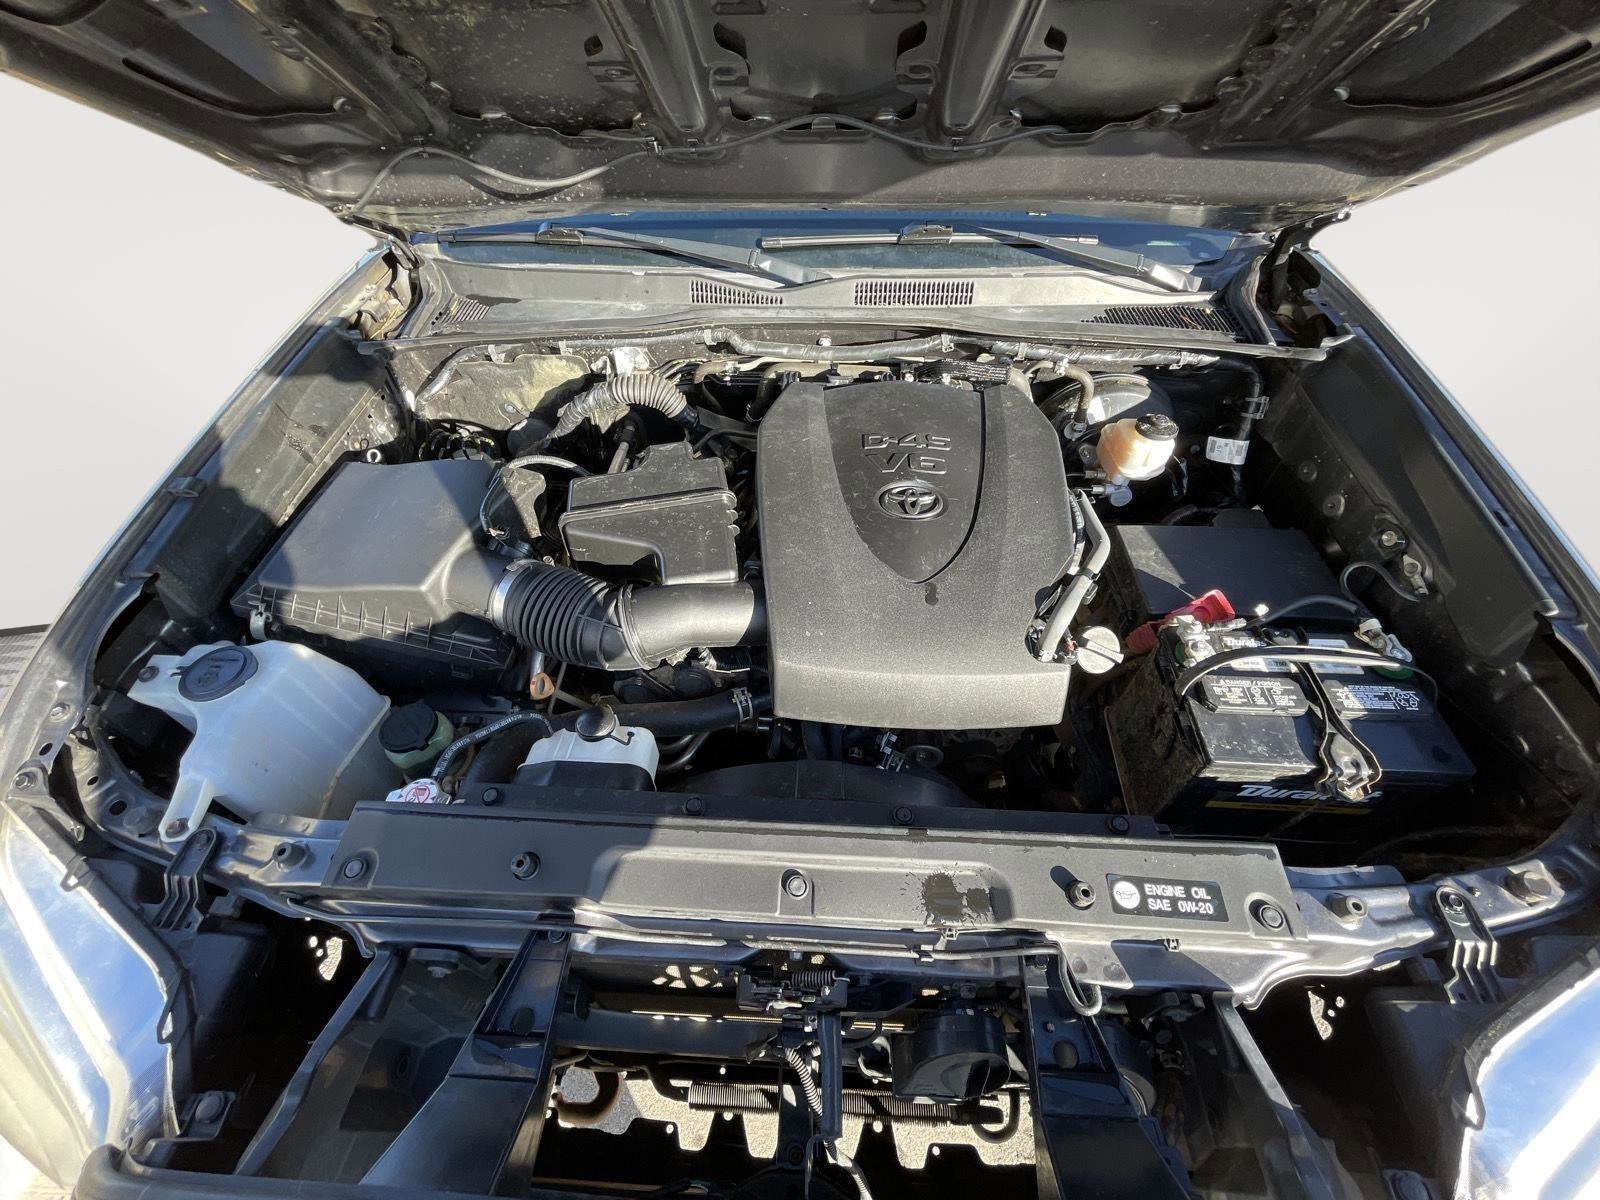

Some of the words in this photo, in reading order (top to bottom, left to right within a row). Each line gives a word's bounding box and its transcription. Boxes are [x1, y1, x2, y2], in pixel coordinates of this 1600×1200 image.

[864, 452, 948, 475] V6
[1144, 883, 1186, 898] ENGINE
[1191, 886, 1212, 900] OIL
[1147, 898, 1172, 911] SAE
[1178, 900, 1214, 914] 0W-20
